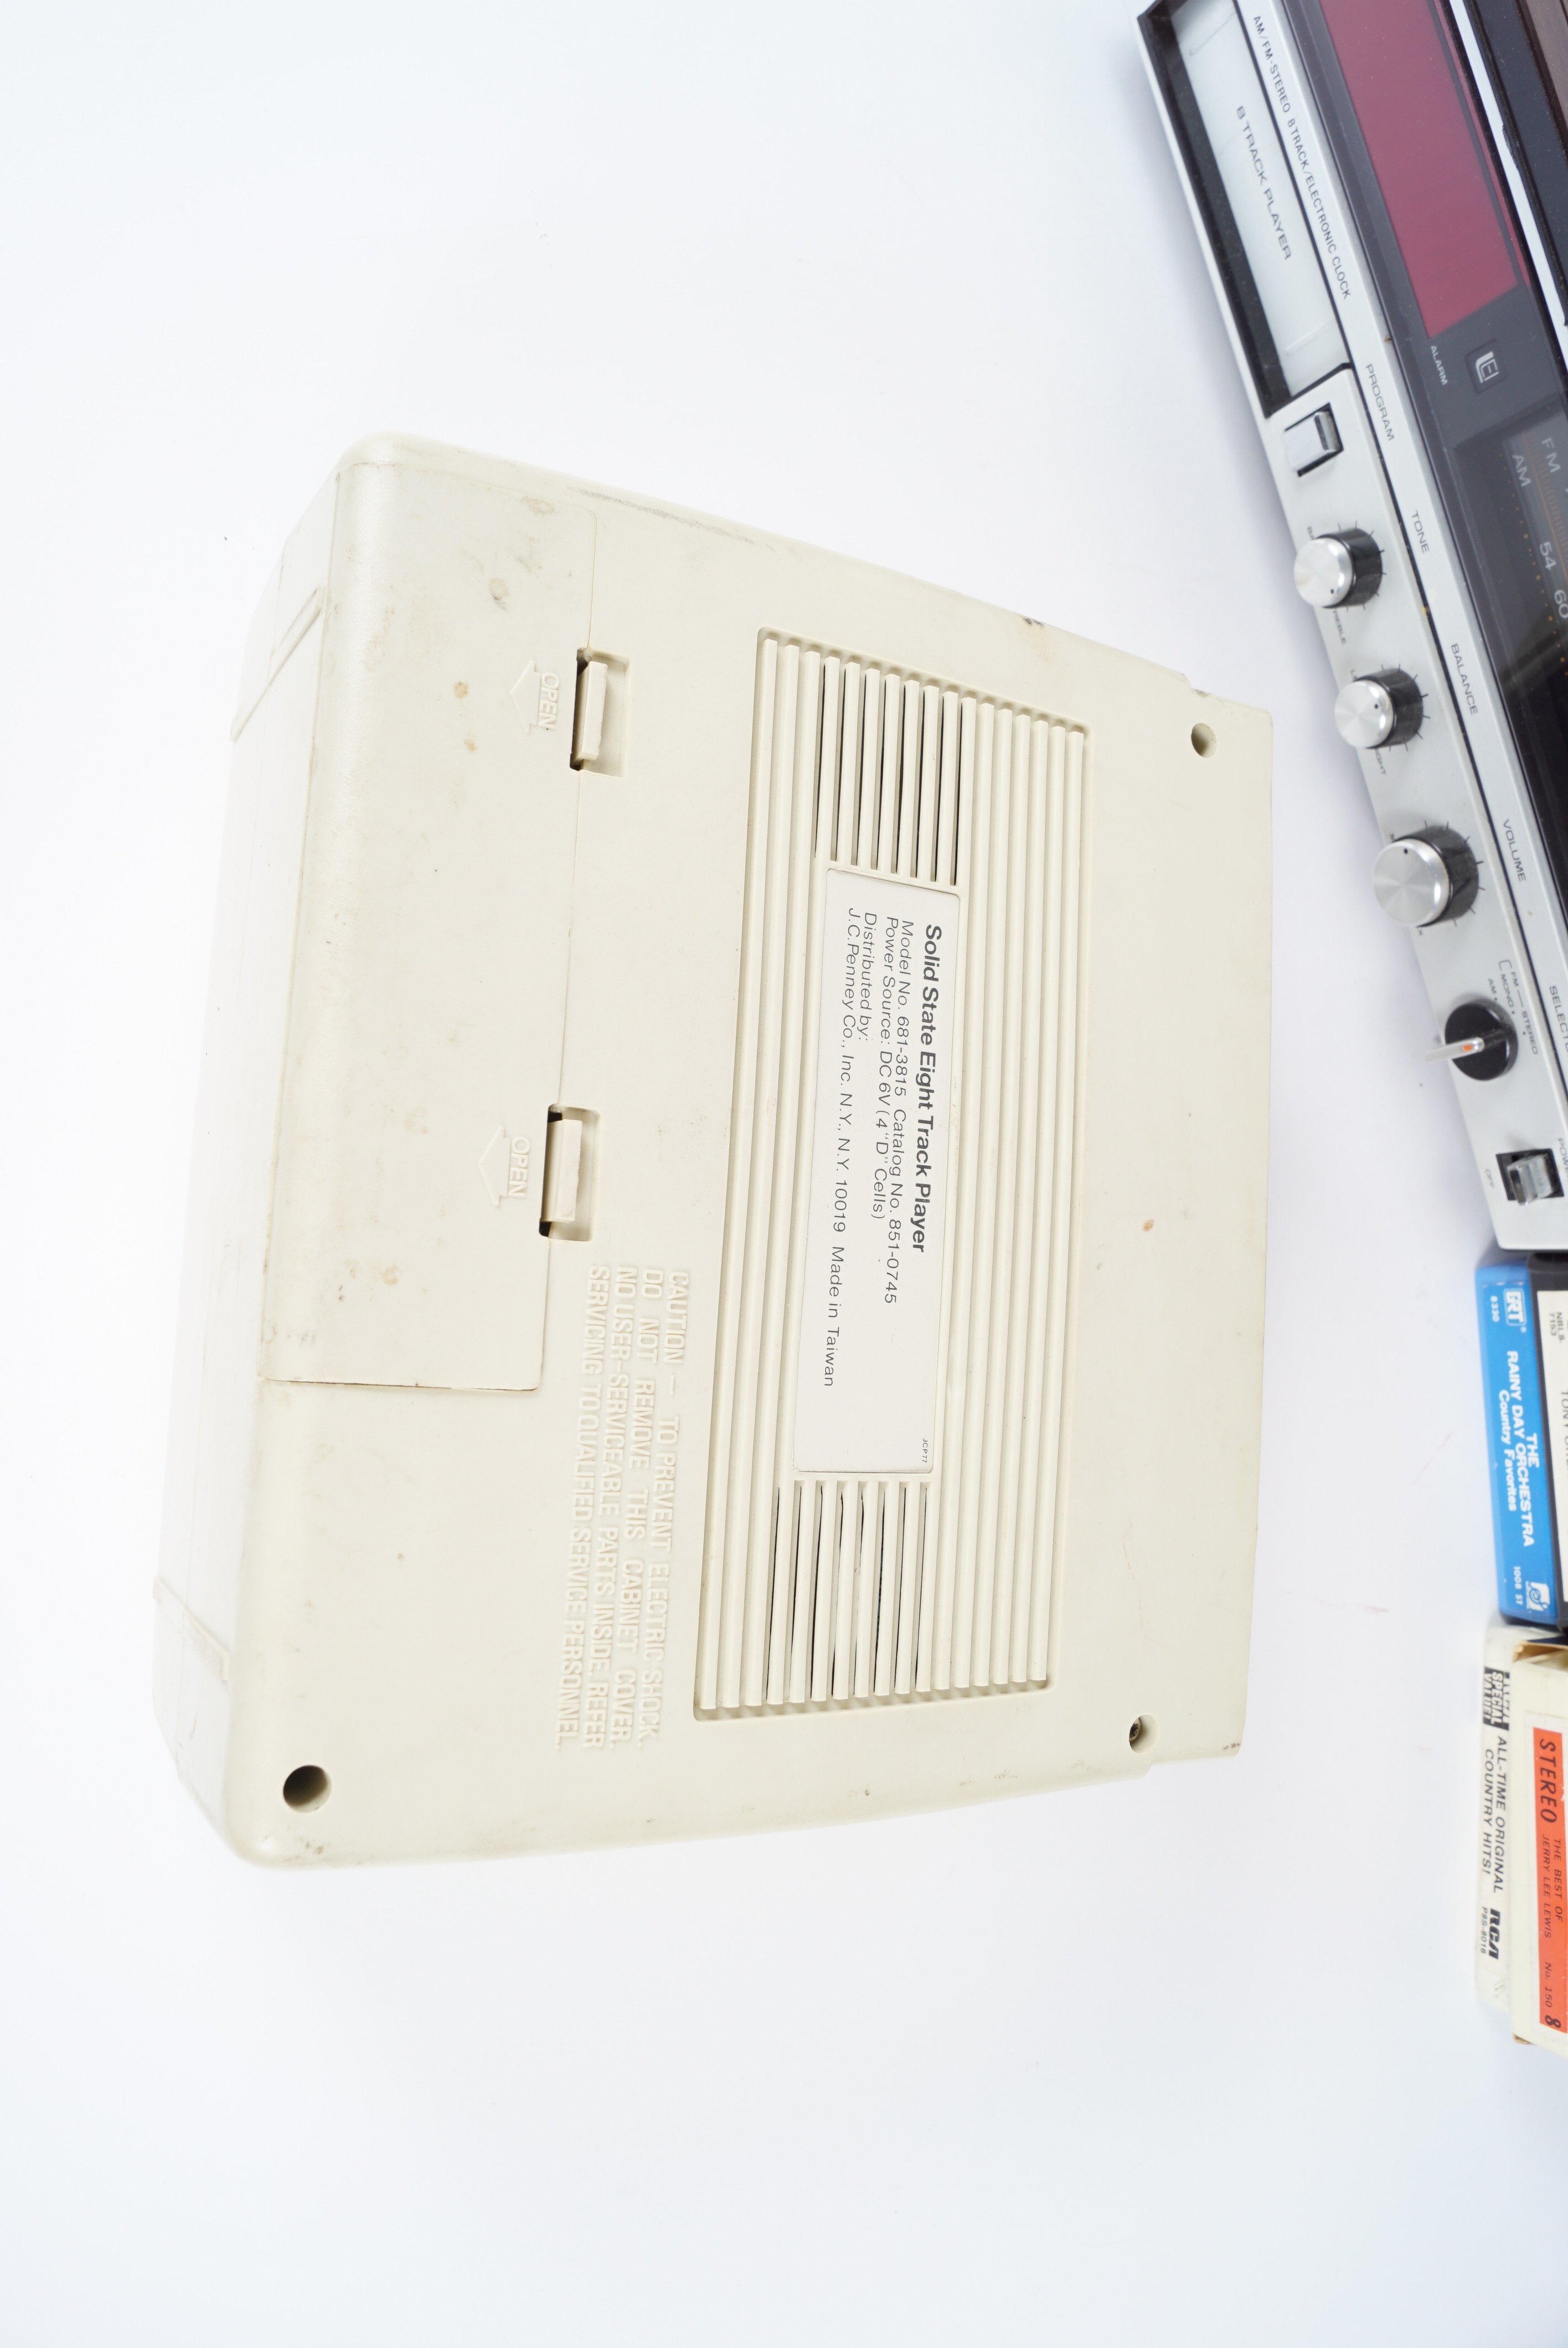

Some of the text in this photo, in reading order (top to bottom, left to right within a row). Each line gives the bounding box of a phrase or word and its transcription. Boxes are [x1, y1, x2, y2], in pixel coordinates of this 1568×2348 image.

[1236, 106, 1292, 260] 8 TRACK PLAYER
[1332, 256, 1352, 300] CLOCK
[1430, 346, 1448, 385] ALARM
[1365, 364, 1395, 441] PROGRAM
[1512, 455, 1531, 487] AM
[1541, 437, 1561, 473] FM
[1411, 510, 1429, 553] TONE
[1540, 542, 1556, 570] 54
[1333, 610, 1347, 644] REBLE
[1554, 590, 1568, 619] 60
[538, 672, 560, 730] OPEN
[1451, 643, 1478, 715] BALANCE
[1503, 818, 1526, 882] VOLUME
[884, 916, 898, 971] Power
[857, 913, 877, 1041] Distributed by:
[1488, 978, 1497, 994] AM
[1501, 974, 1515, 1007] MONO
[841, 1015, 855, 1048] Co.,
[881, 976, 895, 1044] Source:
[1522, 1011, 1538, 1054] STEREO
[840, 1055, 854, 1085] Inc.
[879, 1051, 892, 1077] DC
[911, 924, 942, 1253] Solid State Eight Track Player
[838, 1093, 853, 1130] N.Y.,
[885, 920, 914, 1303] Model No. 681-3815 Catalog No. 851-0745
[508, 1136, 530, 1197] OPEN
[837, 1138, 850, 1172] N.Y.
[833, 1179, 848, 1232] 10019
[871, 1168, 887, 1219] Cells)
[829, 1246, 844, 1296] Made
[828, 1302, 842, 1318] in
[1505, 1291, 1524, 1322] GRT
[824, 1327, 839, 1386] Taiwan
[1499, 1389, 1517, 1511] Country Favorites
[1507, 1351, 1534, 1547] RAINY DAY ORCHESTRA
[1526, 1433, 1539, 1468] THE
[555, 1265, 610, 1750] SERVICING TO QUALIFIED SERVICE PERSONNEL.
[584, 1266, 638, 1748] NO USER-SERVICEABLE PARTS INSIDE. REFER
[610, 1269, 664, 1749] DO NOT REMOVE THIS CABINET COVER.
[637, 1271, 689, 1747] CAUTION TO PREVENT ELECTRIC SHOCK.
[1490, 1672, 1504, 1725] SPECIAL
[1496, 1736, 1507, 1811] ALL-TIME
[1540, 1739, 1557, 1822] STEREO
[1482, 1749, 1494, 1875] COUNTRY HITS!
[1494, 1816, 1505, 1893] ORIGINAL
[1554, 1868, 1562, 1899] BEST
[1489, 1908, 1500, 1960] RCA
[1555, 1906, 1563, 1923] OF
[1545, 2015, 1561, 2028] 8
